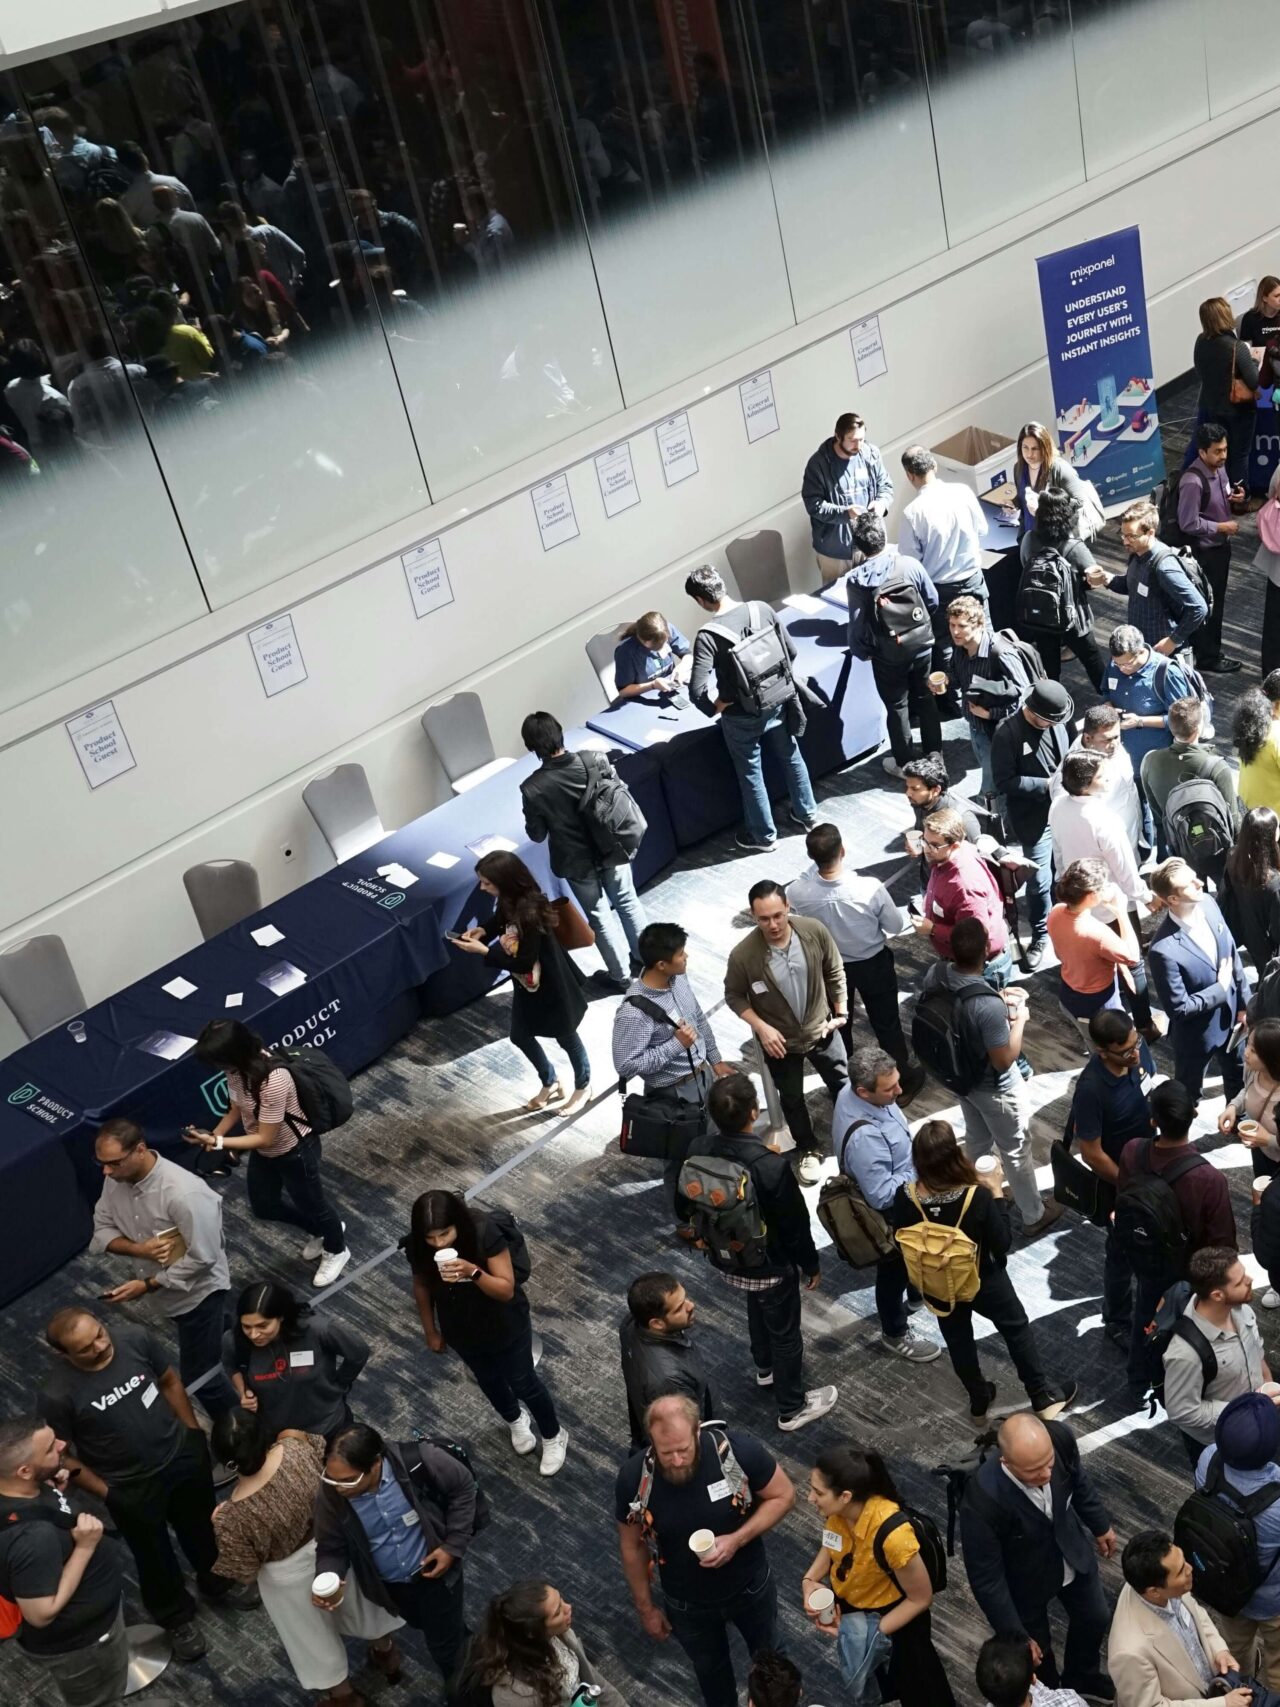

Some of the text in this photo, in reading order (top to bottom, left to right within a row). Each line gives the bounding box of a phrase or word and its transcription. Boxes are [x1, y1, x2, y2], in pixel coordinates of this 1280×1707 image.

[1069, 254, 1115, 280] mixpanel
[1064, 285, 1126, 313] UNDERSTAND
[1067, 300, 1128, 329] EVERY USER'S
[1066, 313, 1132, 345] JOURNEY WITH
[1061, 325, 1141, 361] INSTANT INSIGHTS
[413, 566, 440, 583] Product
[417, 574, 440, 589] School
[262, 643, 292, 661] Product
[267, 650, 292, 667] School
[271, 659, 293, 673] Guest
[83, 730, 116, 751] Product
[89, 739, 117, 758] School
[93, 748, 118, 763] Guest
[341, 881, 378, 899] PRODUCT
[357, 878, 387, 893] SCHOOL
[268, 998, 341, 1050] ODUCT
[26, 1104, 58, 1124] SCHOOL
[37, 1095, 75, 1119] PRODUCT
[91, 1374, 145, 1411] Value.
